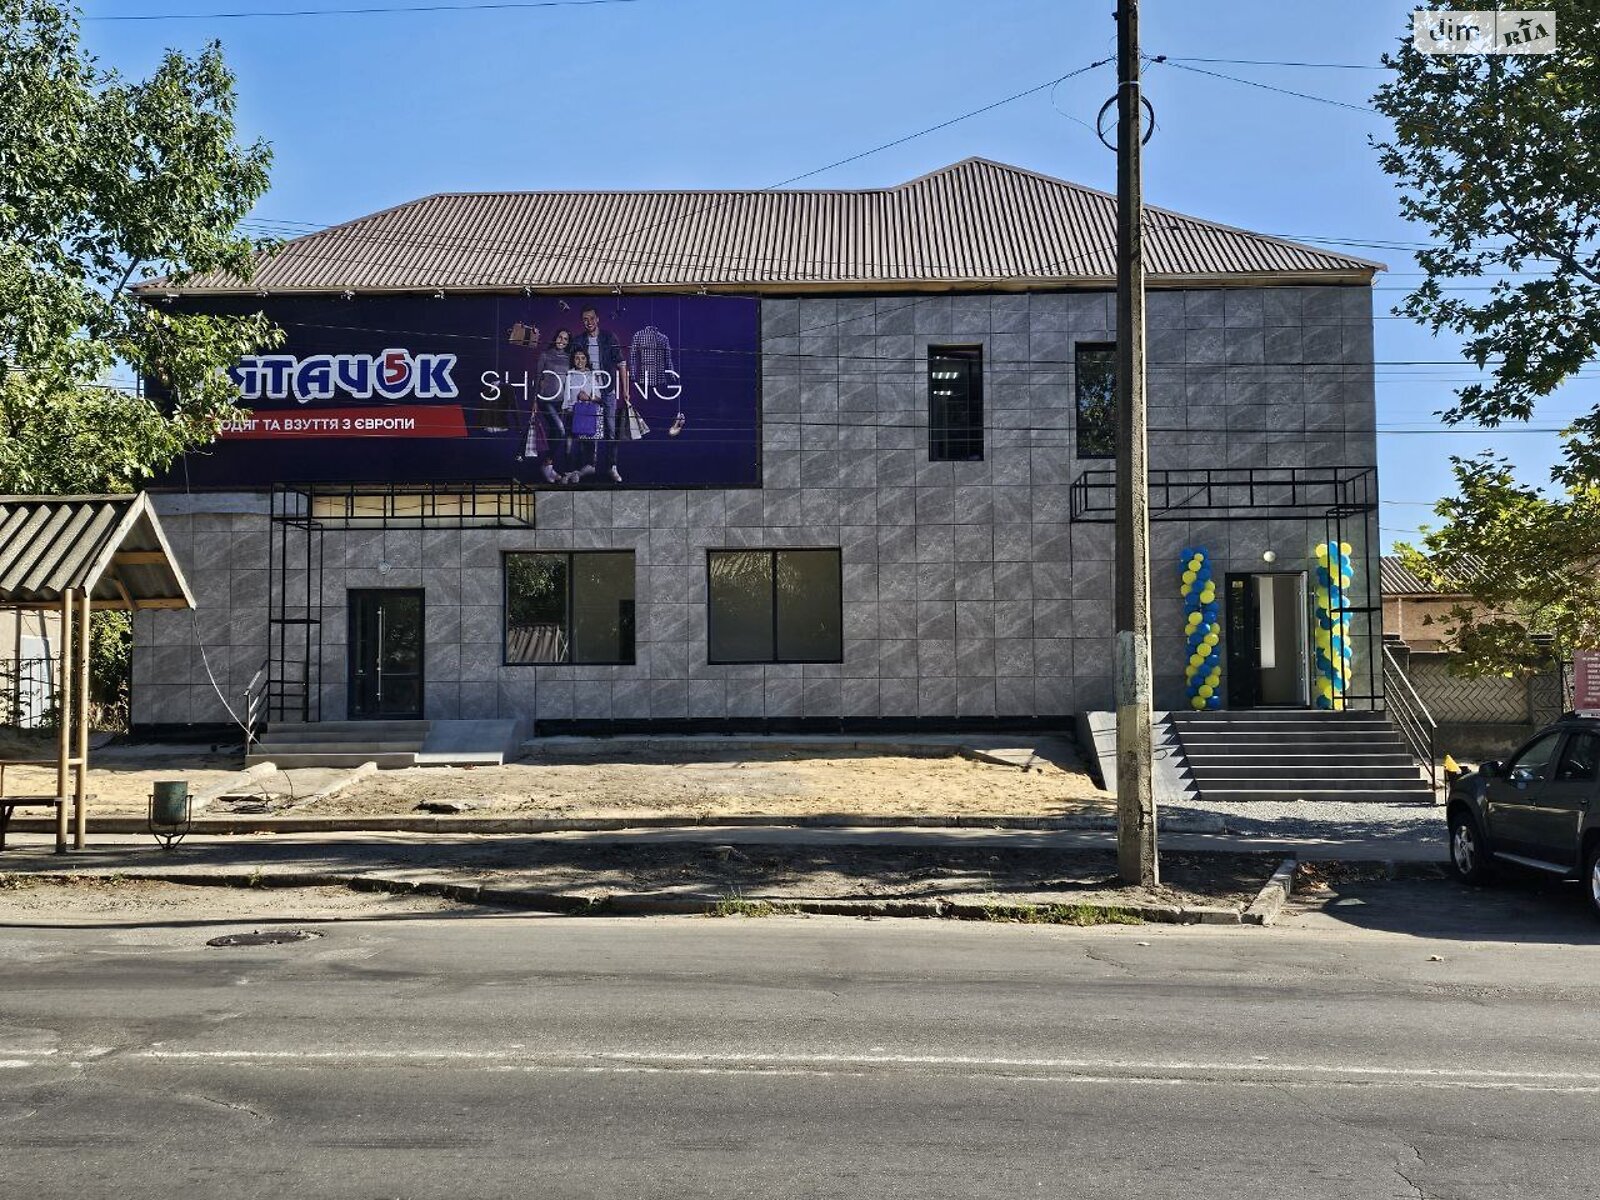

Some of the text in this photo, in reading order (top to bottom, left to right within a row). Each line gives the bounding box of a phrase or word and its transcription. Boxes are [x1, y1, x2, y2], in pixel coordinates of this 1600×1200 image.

[214, 353, 459, 403] ЯТАЧОК
[480, 370, 682, 401] SHOPPING
[220, 419, 259, 433] ОДЯГ
[262, 419, 281, 431] ТА
[284, 418, 339, 431] ВЗУТТЯ
[354, 418, 415, 430] ЄВРОПИ
